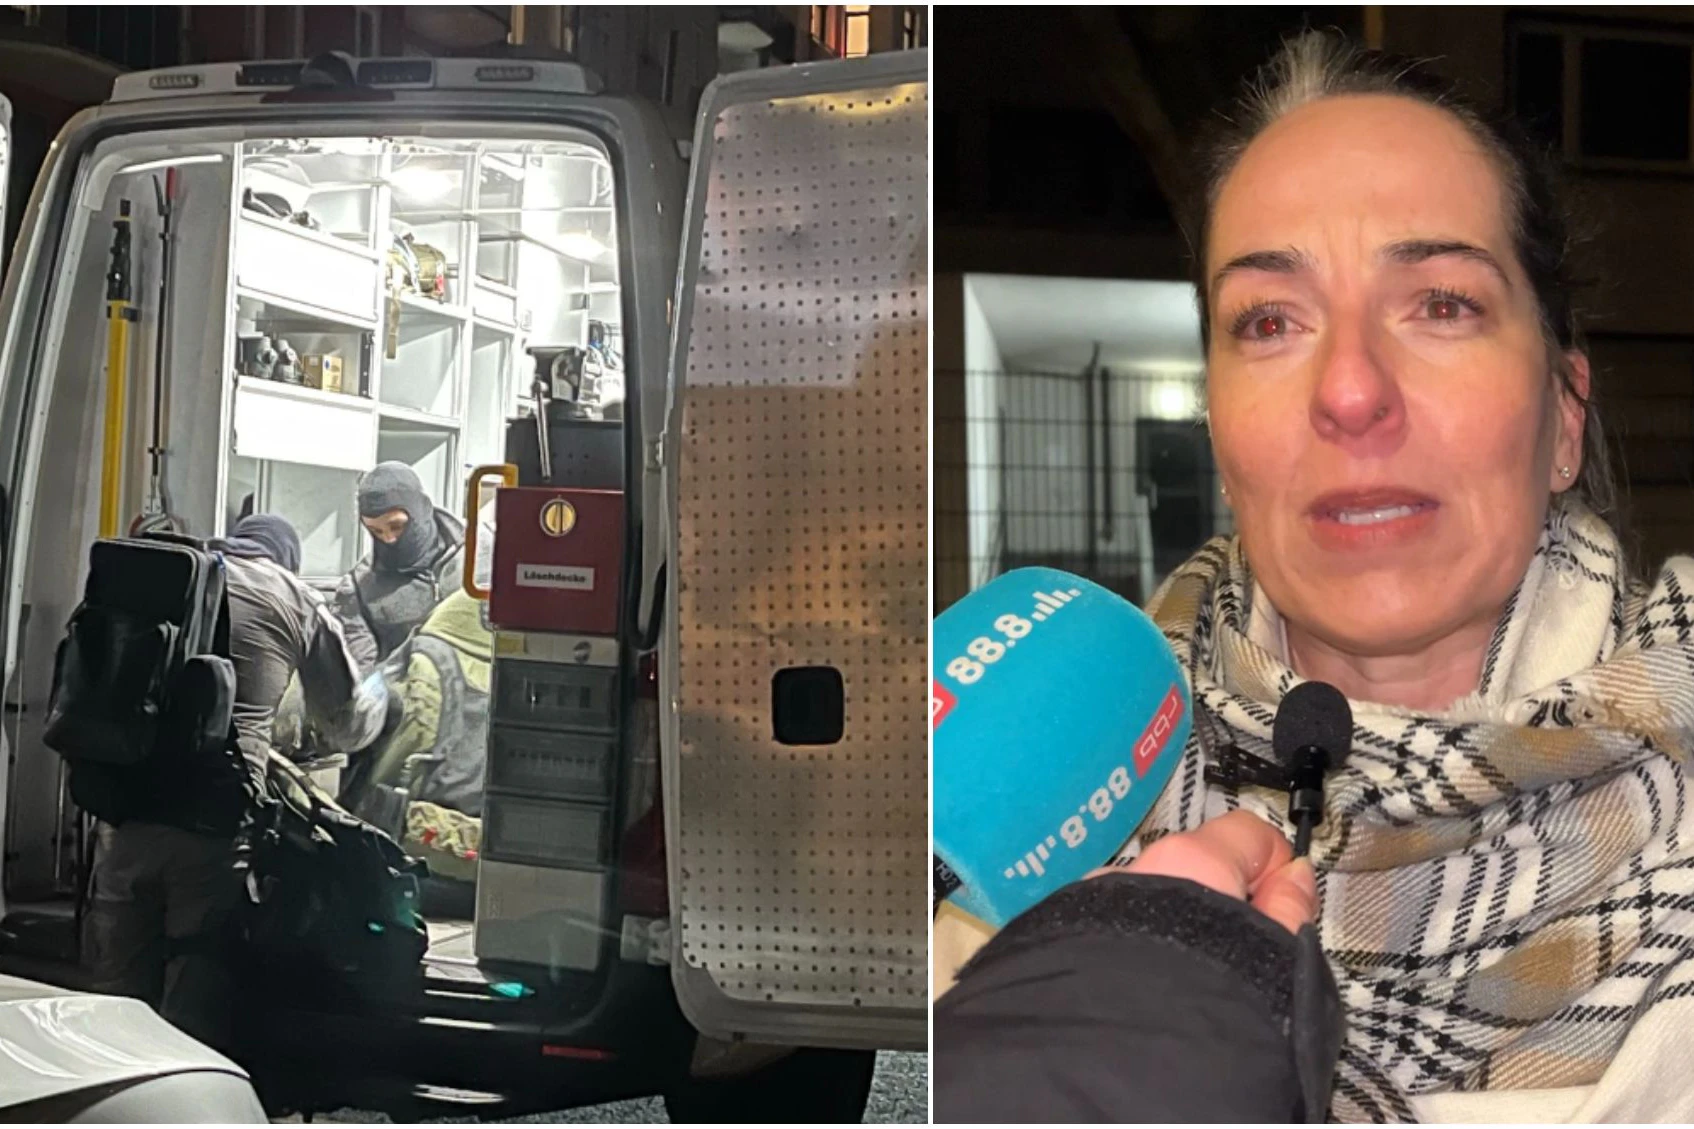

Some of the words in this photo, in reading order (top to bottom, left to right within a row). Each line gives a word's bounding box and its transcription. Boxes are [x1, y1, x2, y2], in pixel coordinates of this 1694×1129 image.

[524, 570, 586, 583] Löschdecke
[946, 614, 1032, 684] 88.8
[1139, 696, 1178, 758] rbb
[1060, 766, 1132, 848] 88.8
